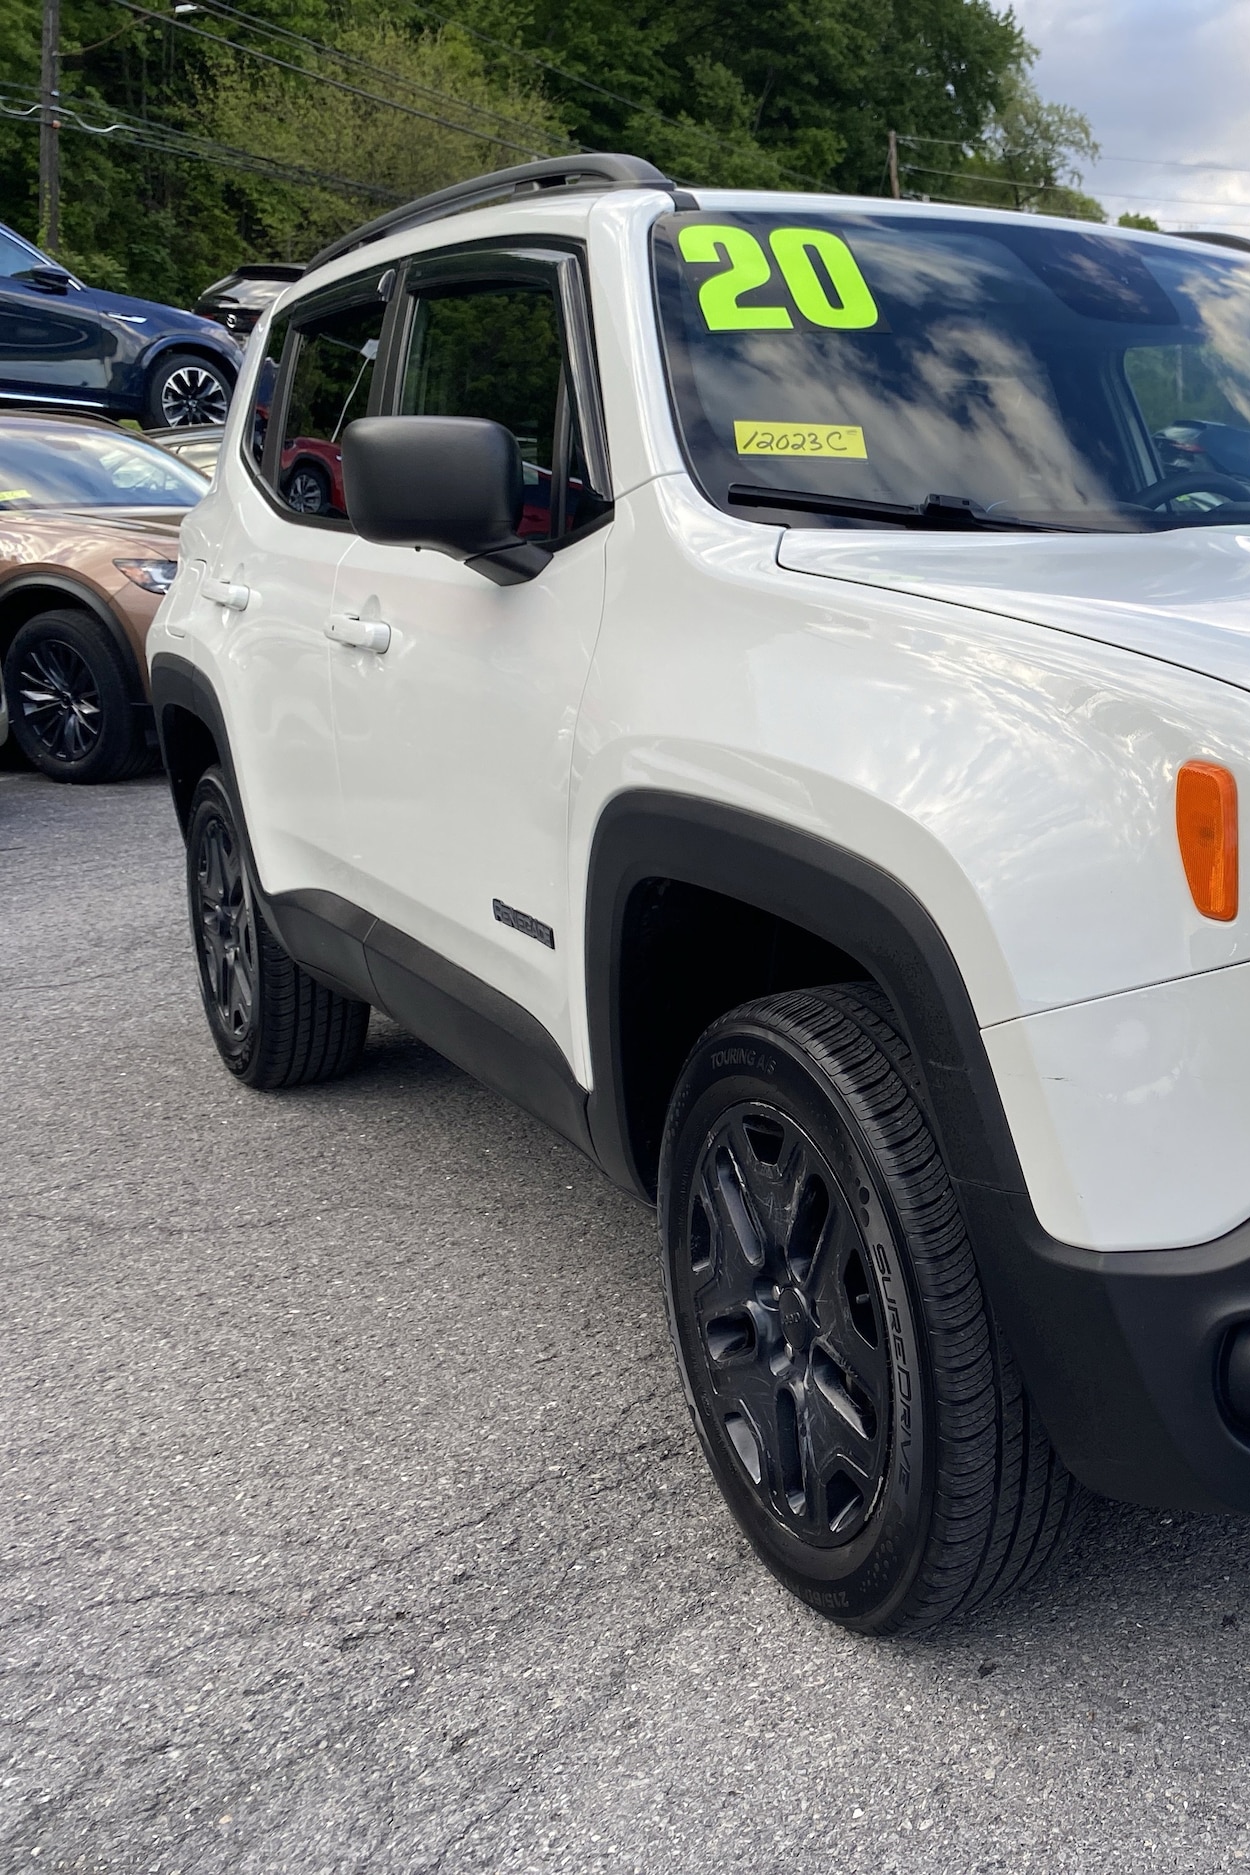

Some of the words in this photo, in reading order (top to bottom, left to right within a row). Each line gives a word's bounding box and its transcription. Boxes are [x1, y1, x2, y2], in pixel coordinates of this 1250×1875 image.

[678, 225, 878, 331] 20
[711, 1048, 757, 1070] TOURING
[872, 1243, 912, 1496] SUREDRIVE
